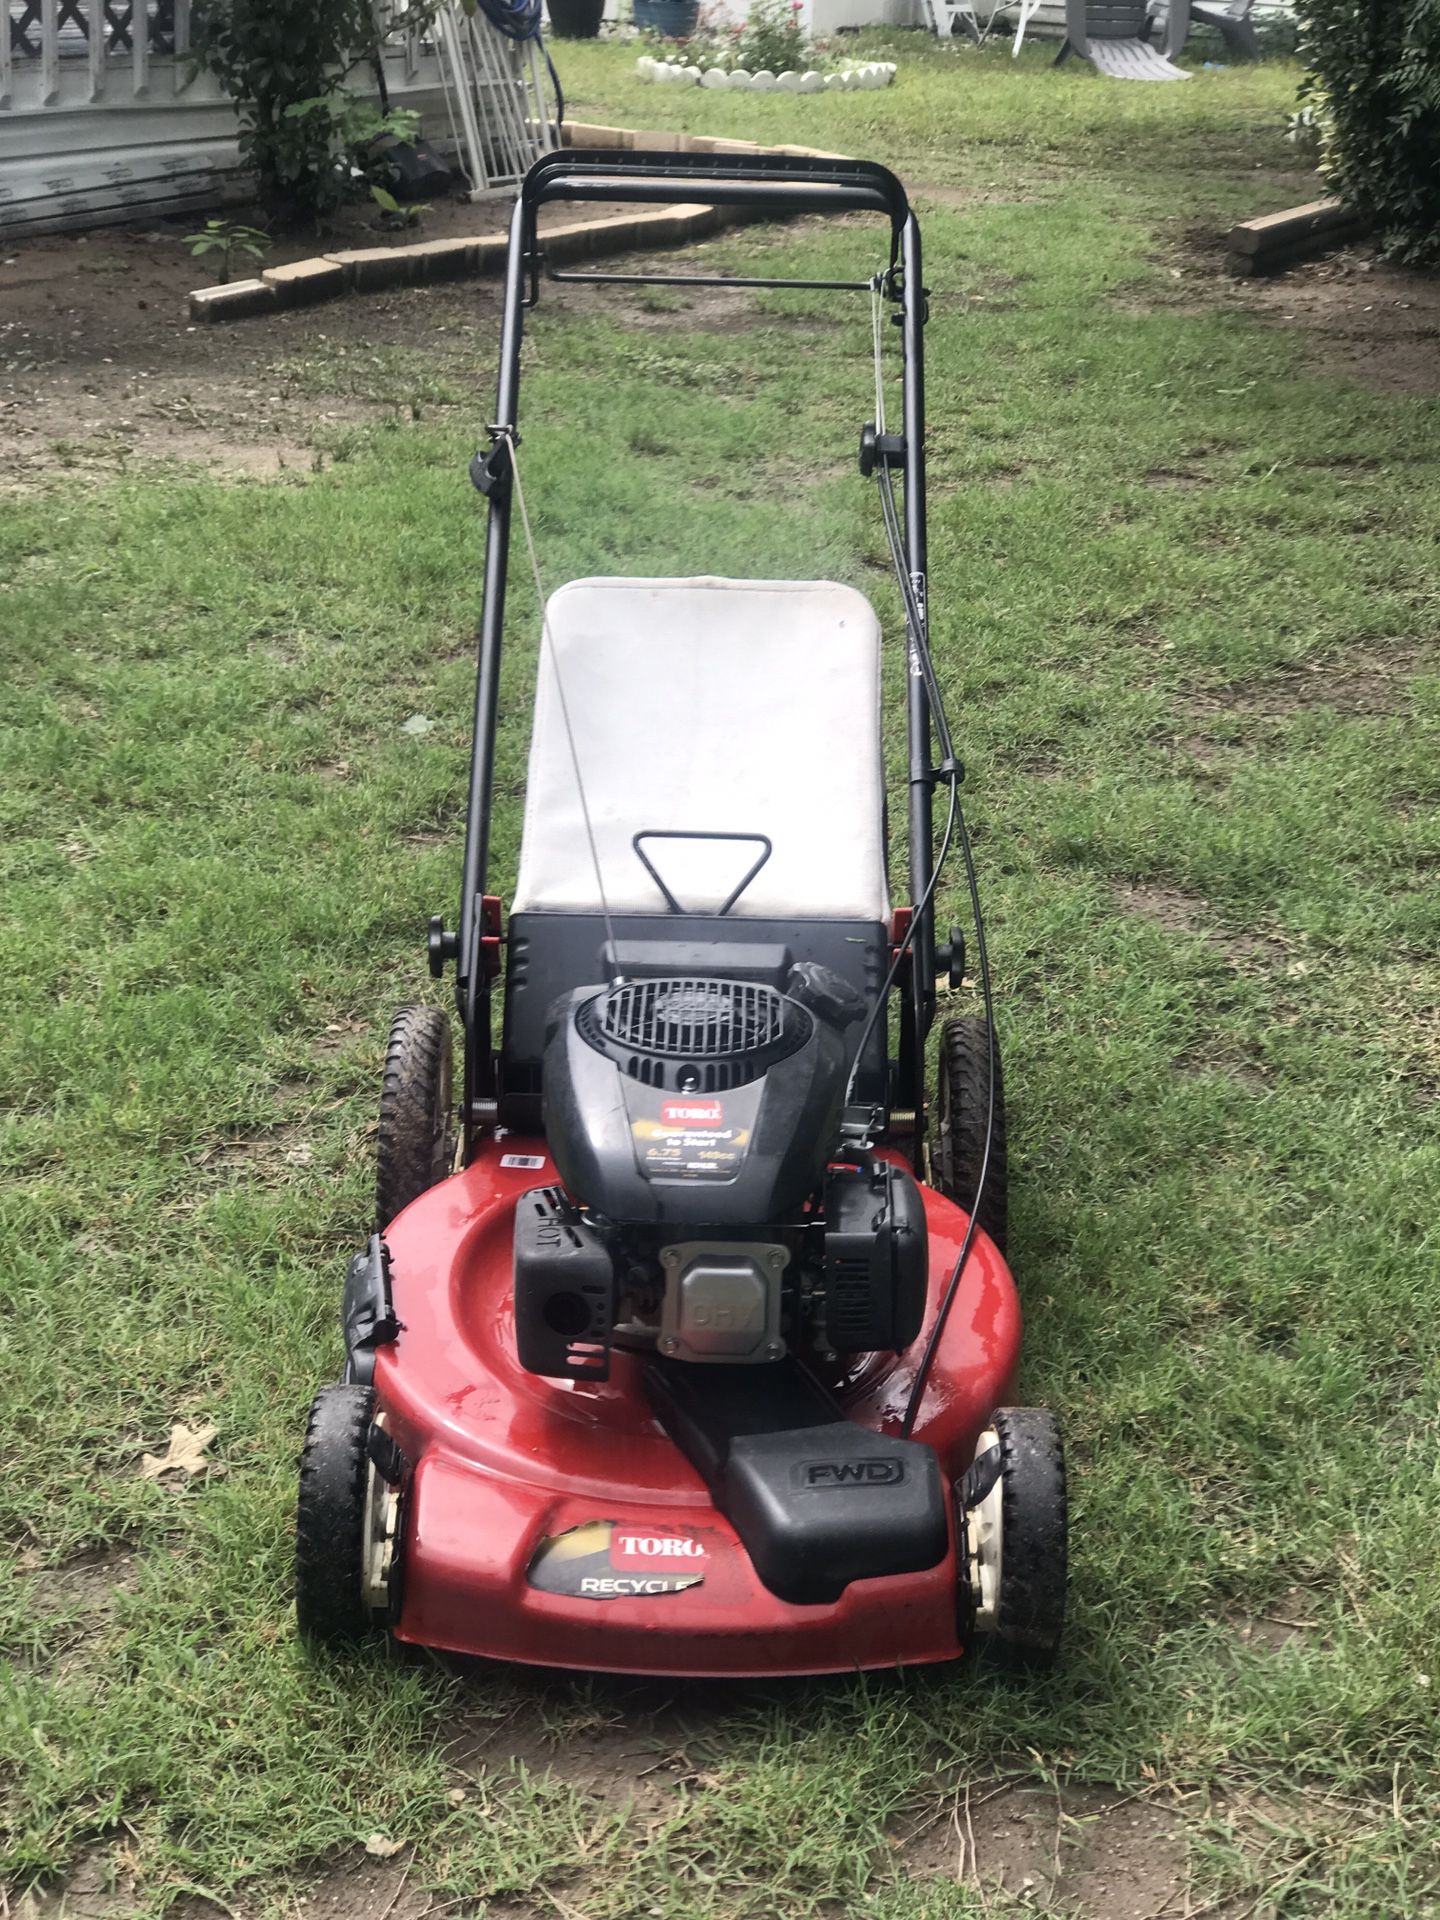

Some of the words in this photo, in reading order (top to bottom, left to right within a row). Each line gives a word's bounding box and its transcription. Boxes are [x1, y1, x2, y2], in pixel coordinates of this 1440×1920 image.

[664, 1107, 722, 1119] TORO
[536, 1217, 562, 1248] HOT
[808, 1463, 893, 1484] FWD
